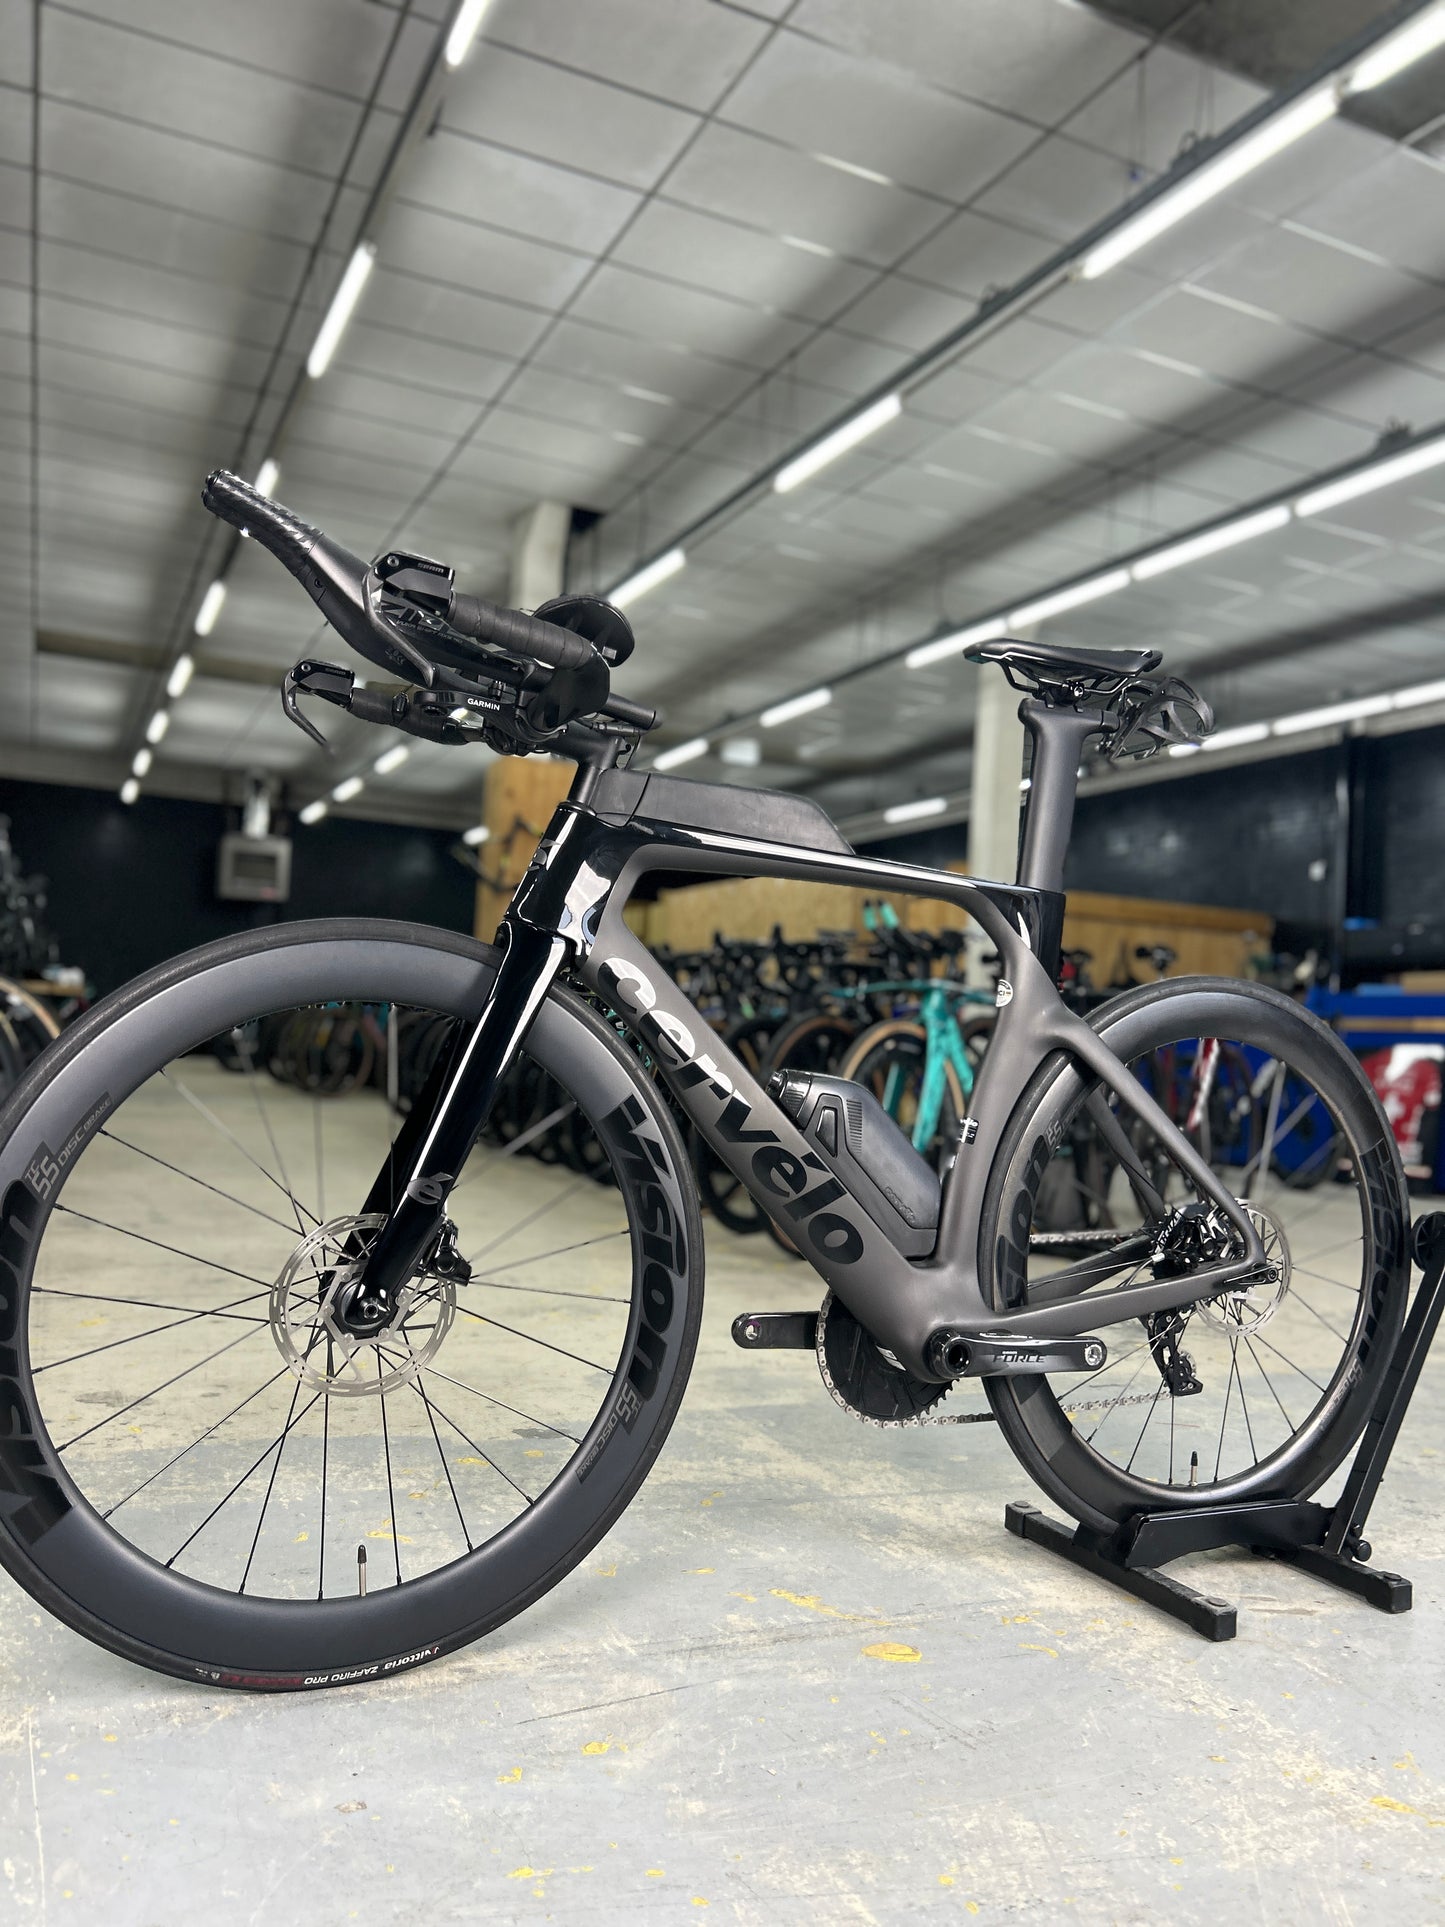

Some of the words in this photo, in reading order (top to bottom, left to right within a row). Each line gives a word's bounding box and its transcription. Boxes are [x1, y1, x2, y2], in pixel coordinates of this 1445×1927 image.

[467, 698, 500, 711] GARMIN
[597, 957, 864, 1265] cervélo
[58, 1127, 85, 1167] DISC
[25, 1160, 40, 1181] TC
[31, 1155, 60, 1200] 55
[993, 1354, 1045, 1363] FORCE
[616, 1382, 637, 1422] 55
[597, 1412, 619, 1449] DISC
[384, 1650, 431, 1670] vittoria
[304, 1673, 328, 1685] PRO
[331, 1665, 379, 1682] ZAFFIRO
